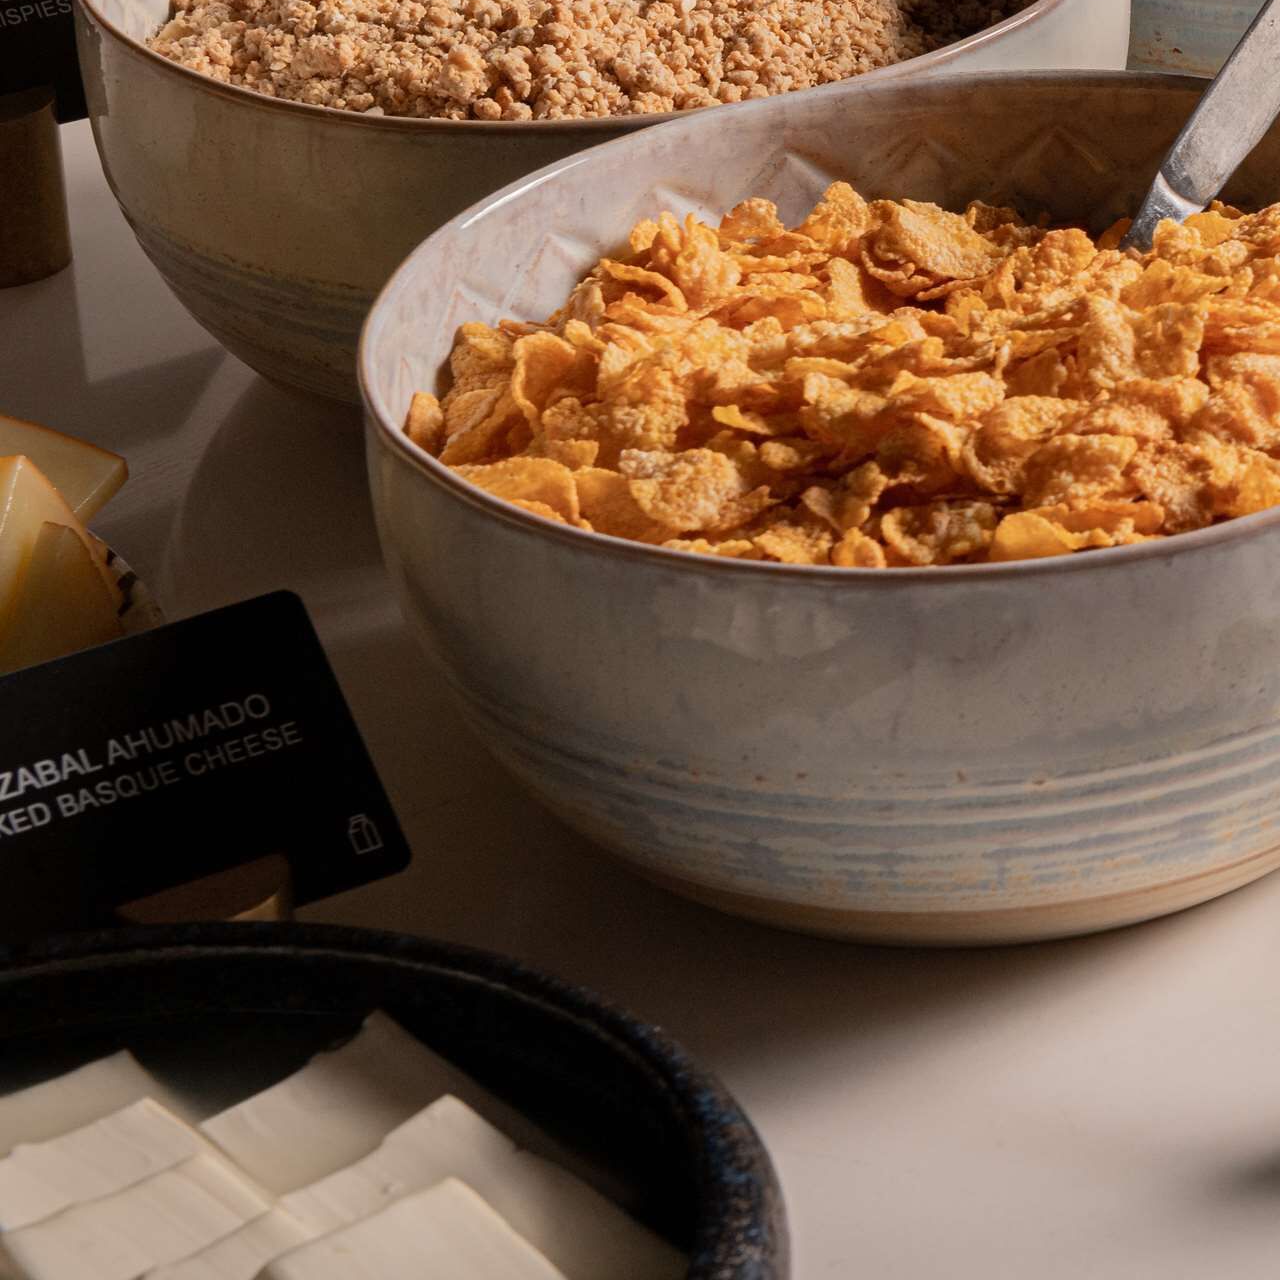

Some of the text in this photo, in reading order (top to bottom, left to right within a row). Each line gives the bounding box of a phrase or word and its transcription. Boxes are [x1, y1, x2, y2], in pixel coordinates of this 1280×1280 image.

[0, 693, 271, 801] ZABAL AHUMADO
[56, 760, 181, 818] BASQUE
[184, 721, 303, 776] CHEESE
